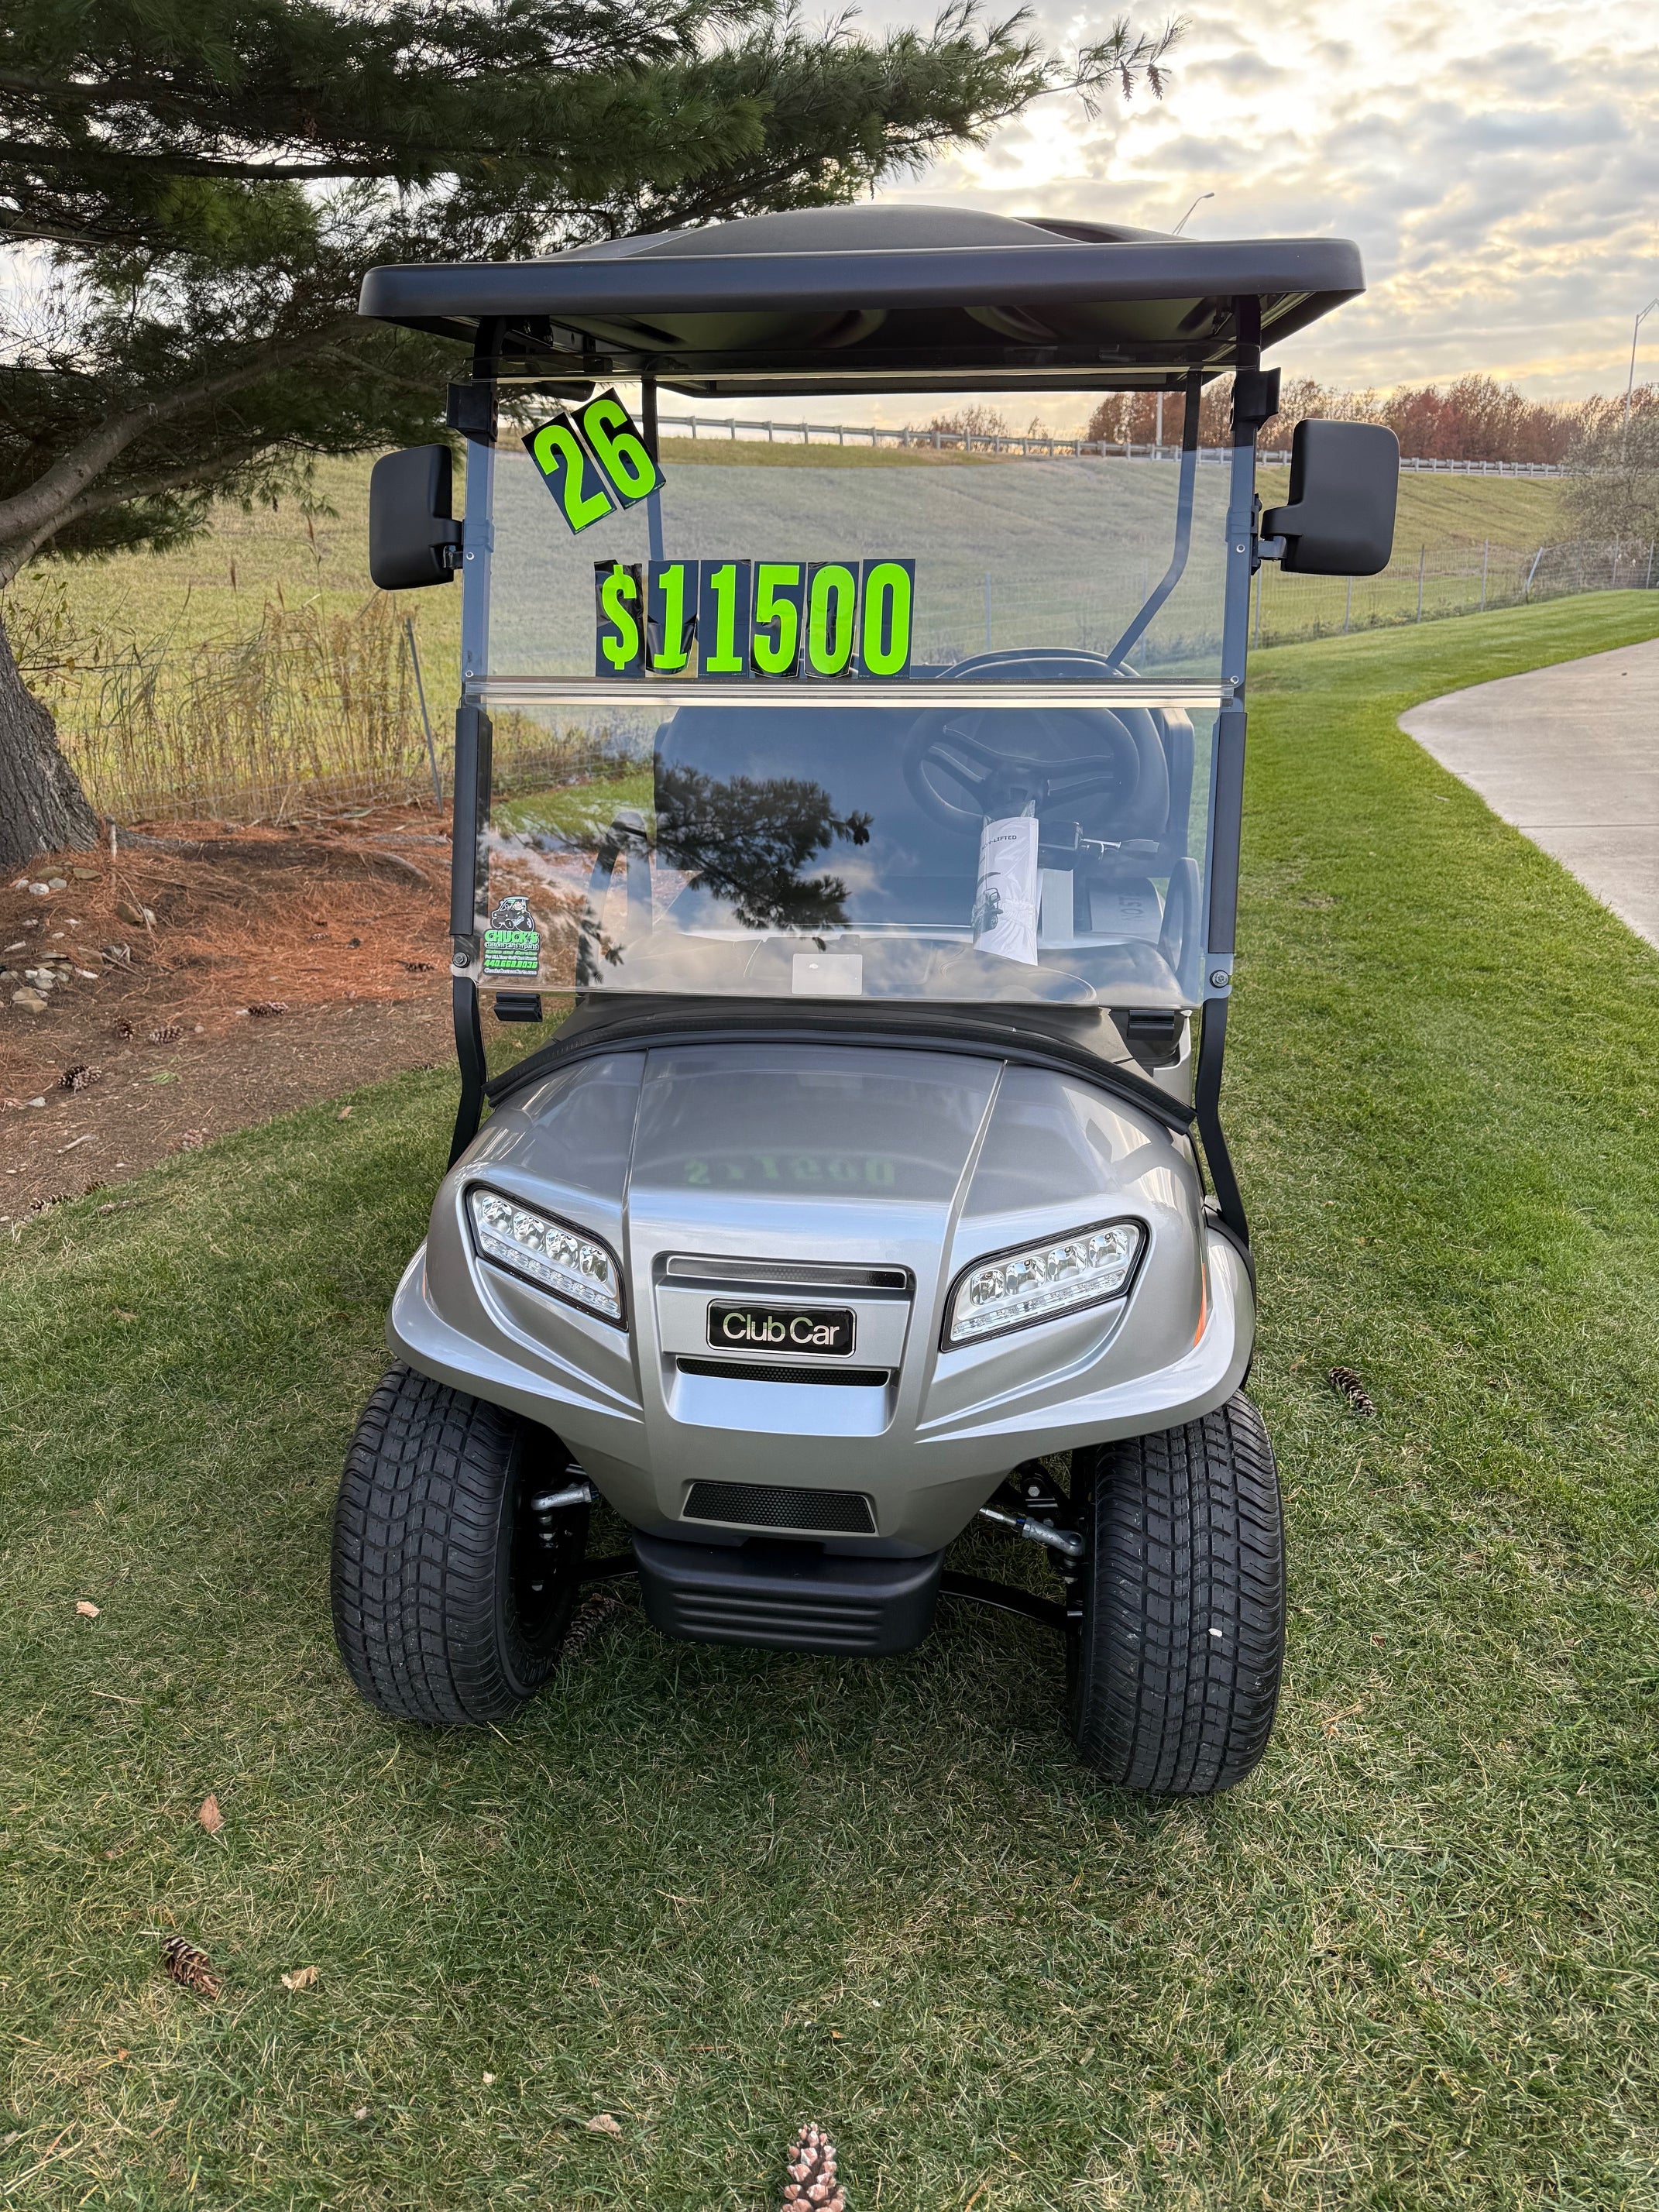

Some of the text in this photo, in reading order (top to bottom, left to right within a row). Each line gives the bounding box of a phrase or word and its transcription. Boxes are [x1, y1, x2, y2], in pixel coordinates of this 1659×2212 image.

[534, 400, 656, 530] 26
[601, 564, 911, 675] $11500
[484, 930, 540, 944] CHUCK'S
[723, 1312, 840, 1345] Club Car
